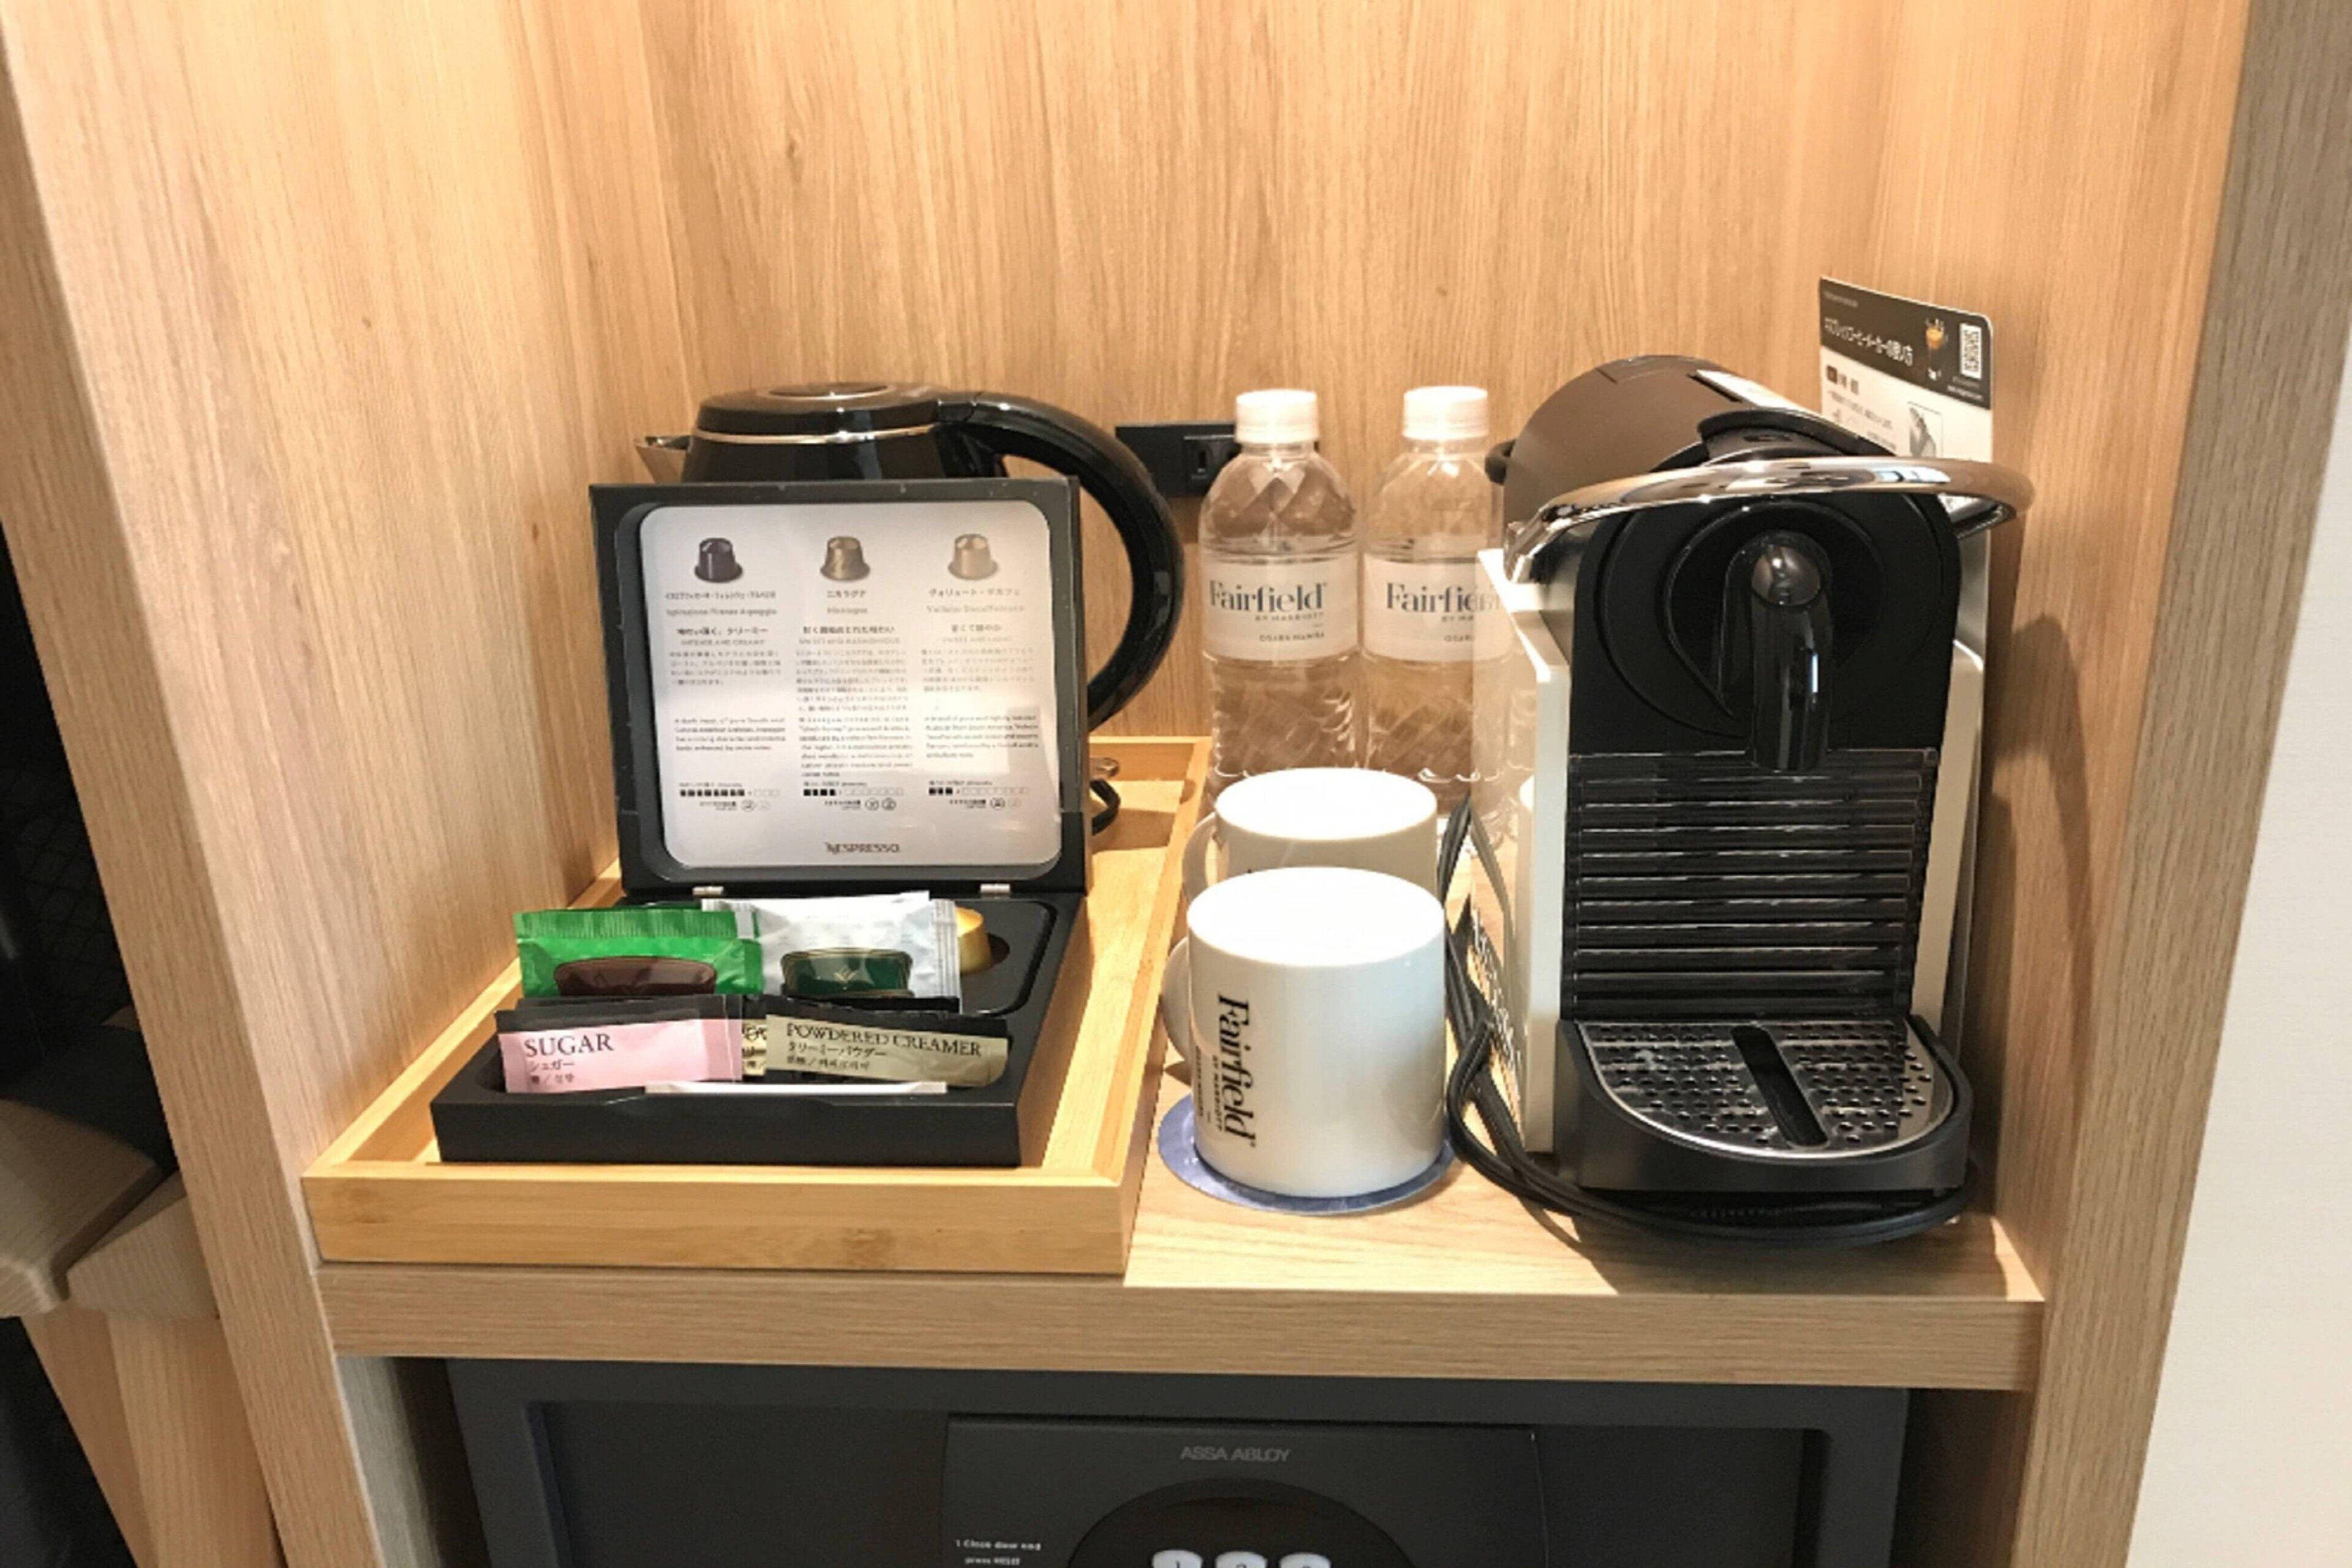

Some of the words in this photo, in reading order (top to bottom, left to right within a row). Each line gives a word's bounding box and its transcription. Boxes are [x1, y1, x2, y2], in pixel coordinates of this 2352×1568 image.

[1210, 580, 1324, 612] Fairfield
[524, 1033, 614, 1057] SUGAR
[786, 1023, 888, 1045] POWDERED
[892, 1035, 981, 1057] CREAMER
[530, 1060, 575, 1071] シュガー
[1218, 994, 1256, 1140] Fairfield
[1181, 1446, 1227, 1460] ASSA
[1231, 1447, 1291, 1462] ABLOY
